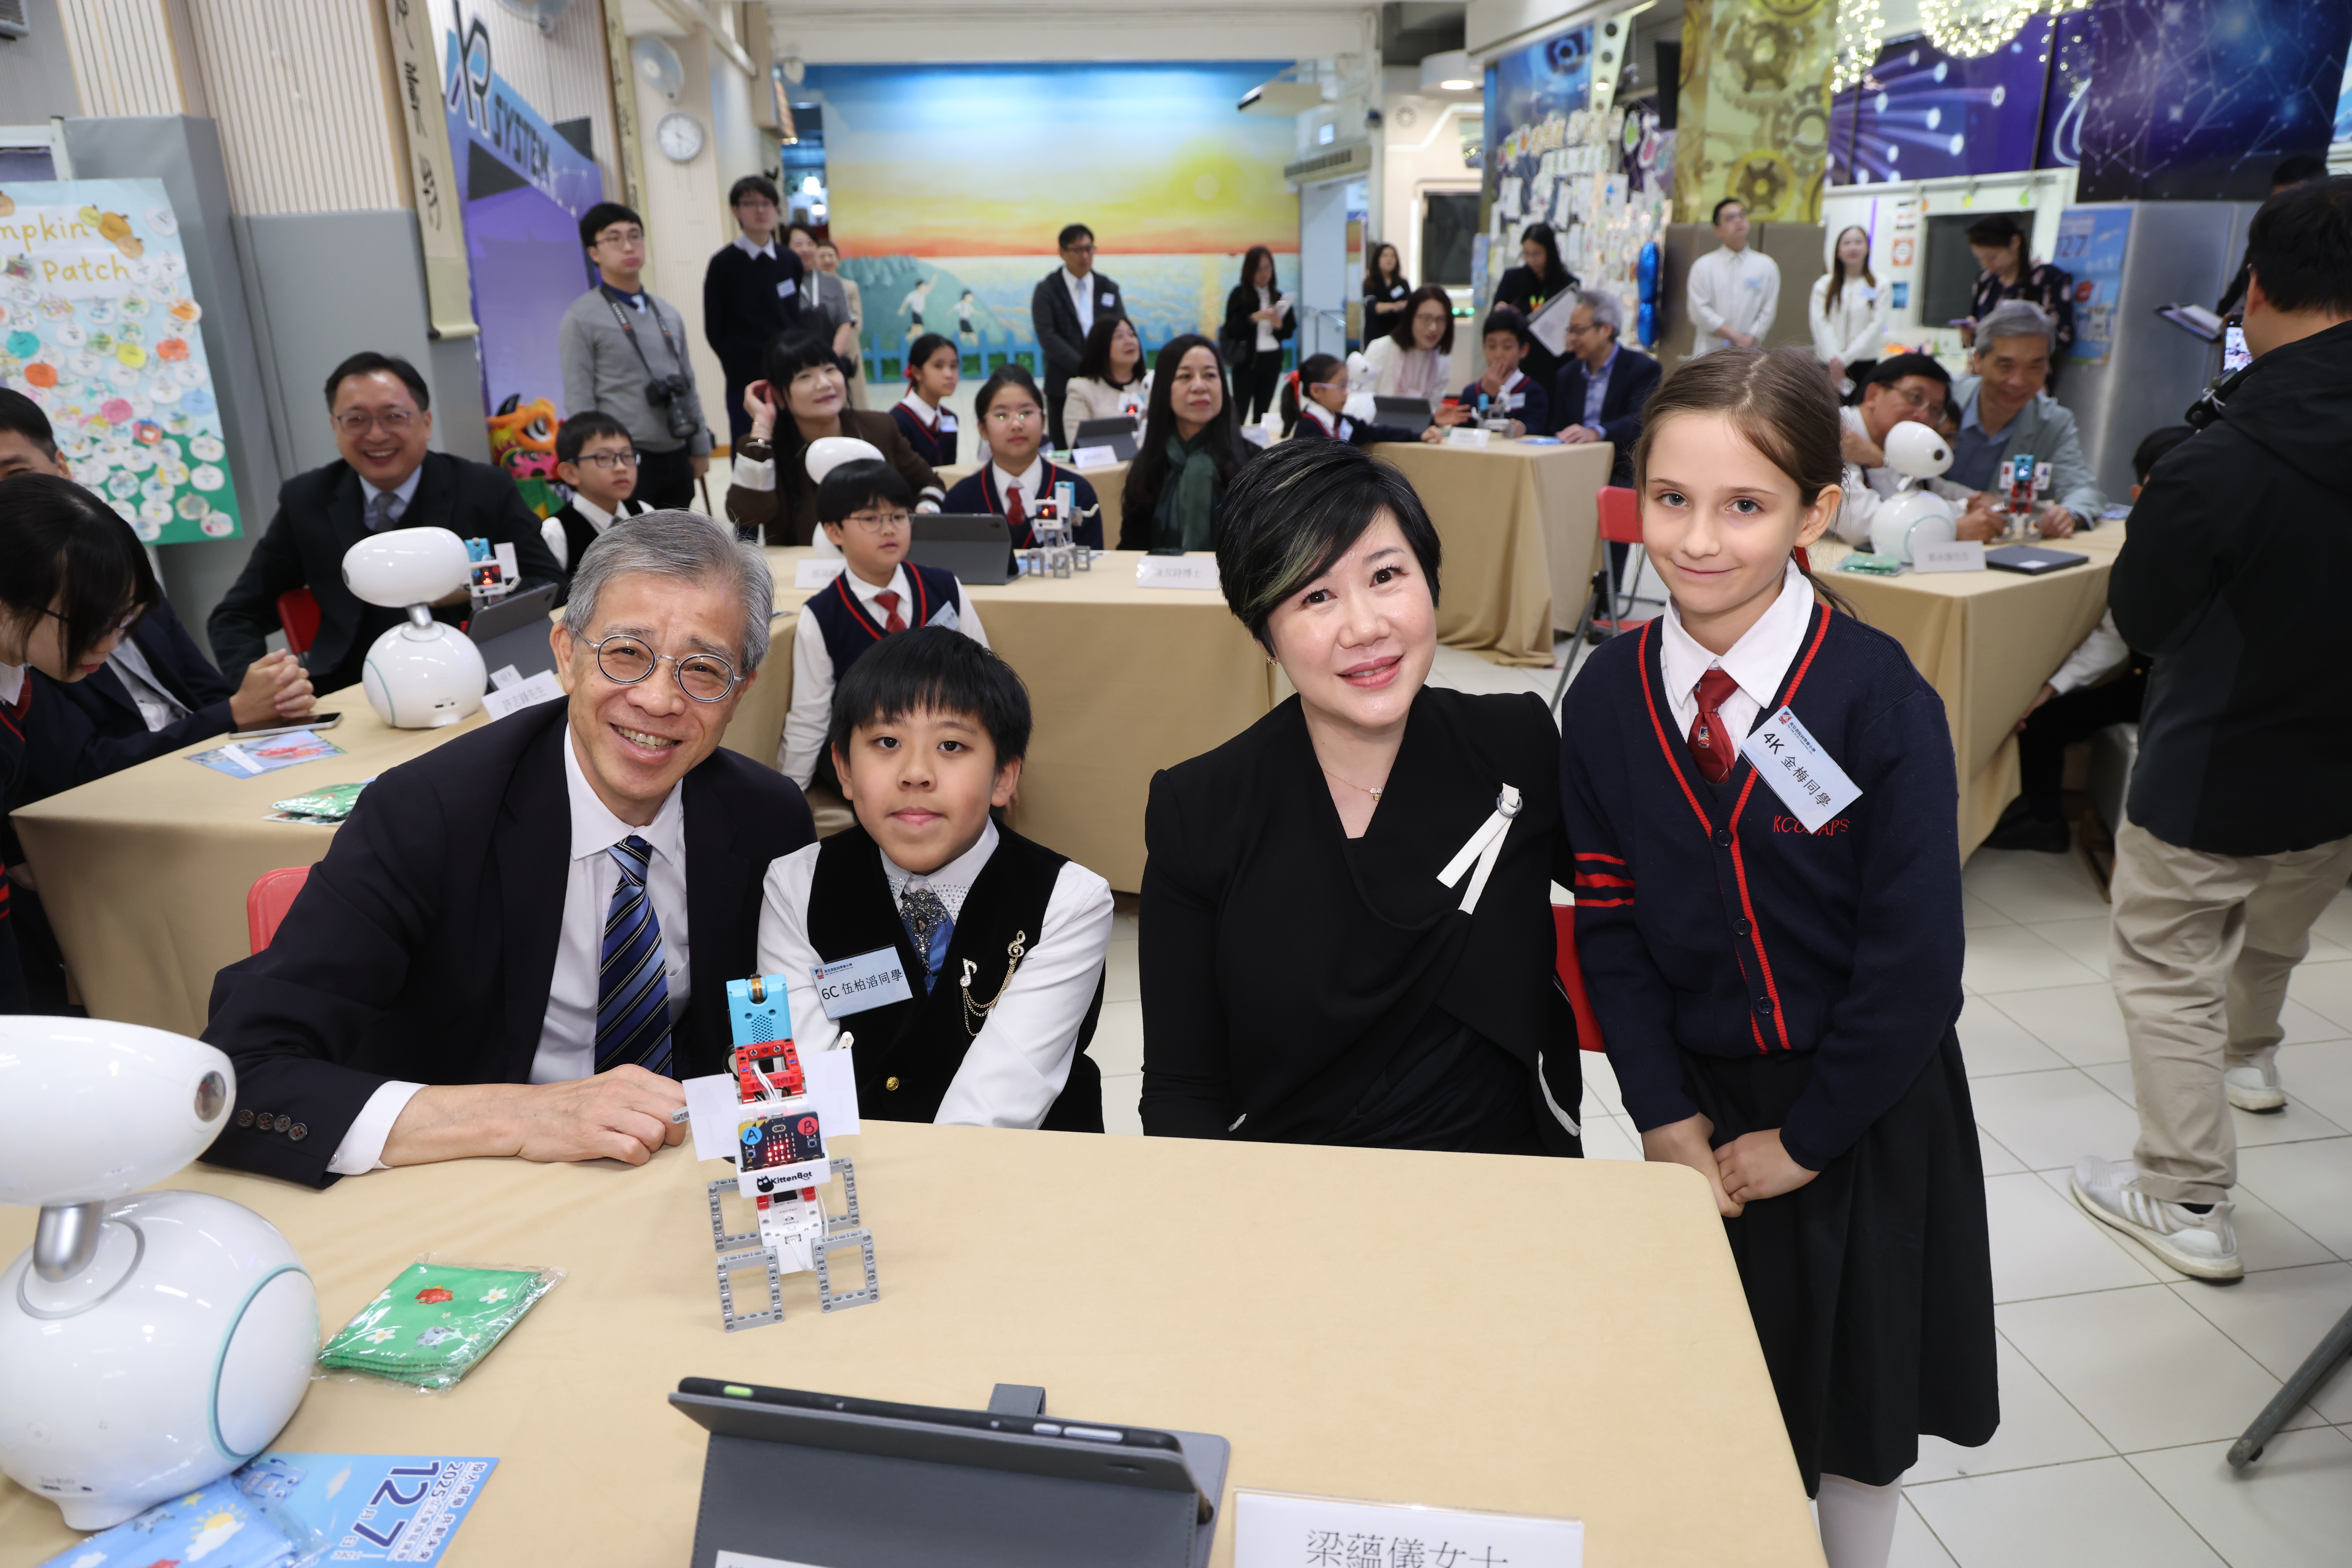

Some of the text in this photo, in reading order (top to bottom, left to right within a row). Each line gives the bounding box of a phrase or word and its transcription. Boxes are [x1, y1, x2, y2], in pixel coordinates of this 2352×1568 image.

[493, 93, 550, 181] SYSTEM
[1789, 722, 1816, 752] 英皇書院同學會小學
[1764, 732, 1831, 808] 4K 金梅同學
[1773, 815, 1851, 836] KCOAPS
[821, 985, 840, 1000] 6C
[842, 968, 903, 996] 伍柏滔同學
[746, 1129, 759, 1142] A
[804, 1120, 815, 1134] B
[771, 1171, 813, 1185] KittenBot
[432, 1463, 463, 1497] 2025
